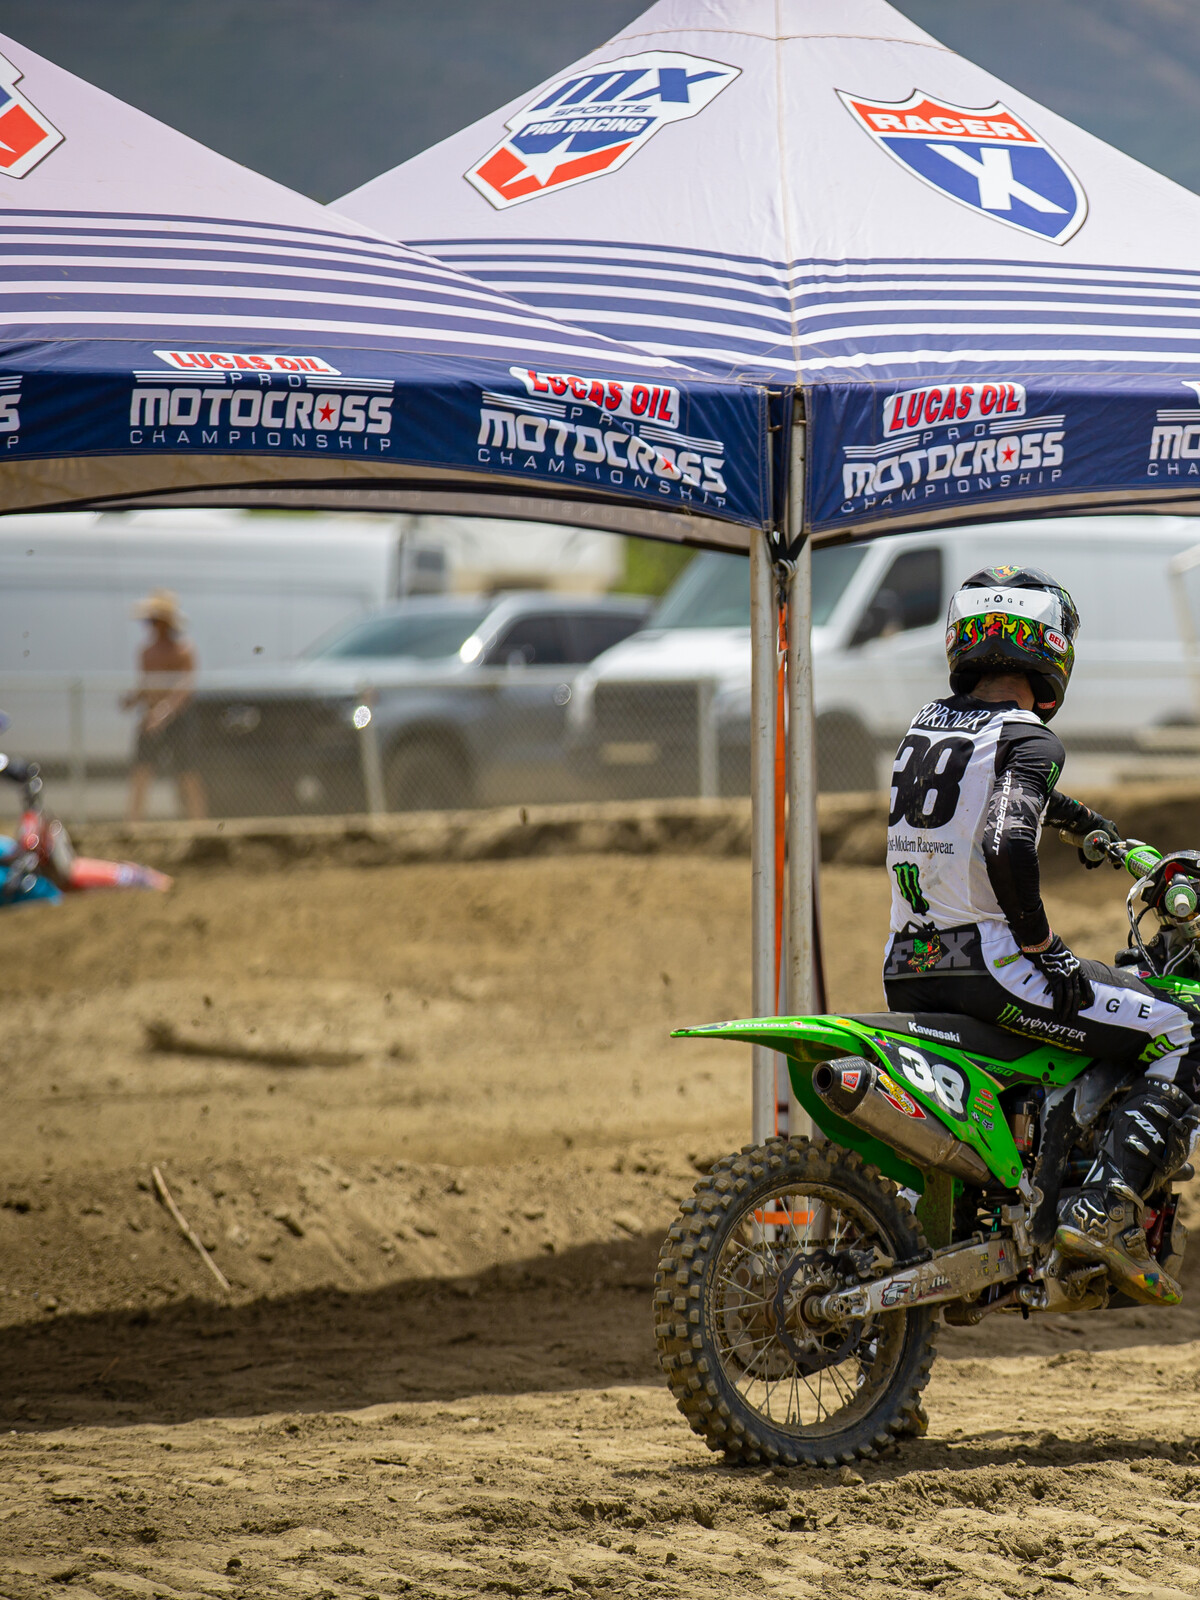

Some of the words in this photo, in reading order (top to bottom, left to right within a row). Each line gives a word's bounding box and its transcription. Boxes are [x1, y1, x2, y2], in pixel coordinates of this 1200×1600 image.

[528, 68, 729, 112] MX
[520, 120, 563, 137] PRO
[563, 117, 649, 134] RACING
[550, 105, 652, 117] SPORTS
[867, 113, 1026, 139] RACER
[925, 143, 1070, 215] X
[169, 352, 272, 371] LUCAS
[274, 356, 330, 373] OIL
[229, 372, 302, 388] PRO
[130, 388, 394, 434] MOTOCROSS
[528, 370, 623, 410] LUCAS
[630, 384, 674, 422] OIL
[889, 386, 974, 432] LUCAS
[979, 384, 1020, 415] OIL
[570, 408, 635, 435] PRO
[922, 424, 986, 445] PRO
[130, 430, 391, 451] CHAMPIONSHIP
[477, 408, 728, 493] MOTOCROSS
[477, 448, 726, 507] CHAMPIONSHIP
[842, 431, 1066, 499] MOTOCROSS
[841, 469, 1063, 513] CHAMPIONSHIP
[1049, 632, 1066, 650] BELL
[888, 733, 976, 829] 38
[992, 796, 1009, 856] CIRCUIT
[917, 836, 955, 855] Racewear.
[908, 1021, 960, 1043] Kawasaki
[897, 1046, 965, 1114] 38
[984, 1064, 1015, 1077] 250
[1124, 1109, 1166, 1145] FOX
